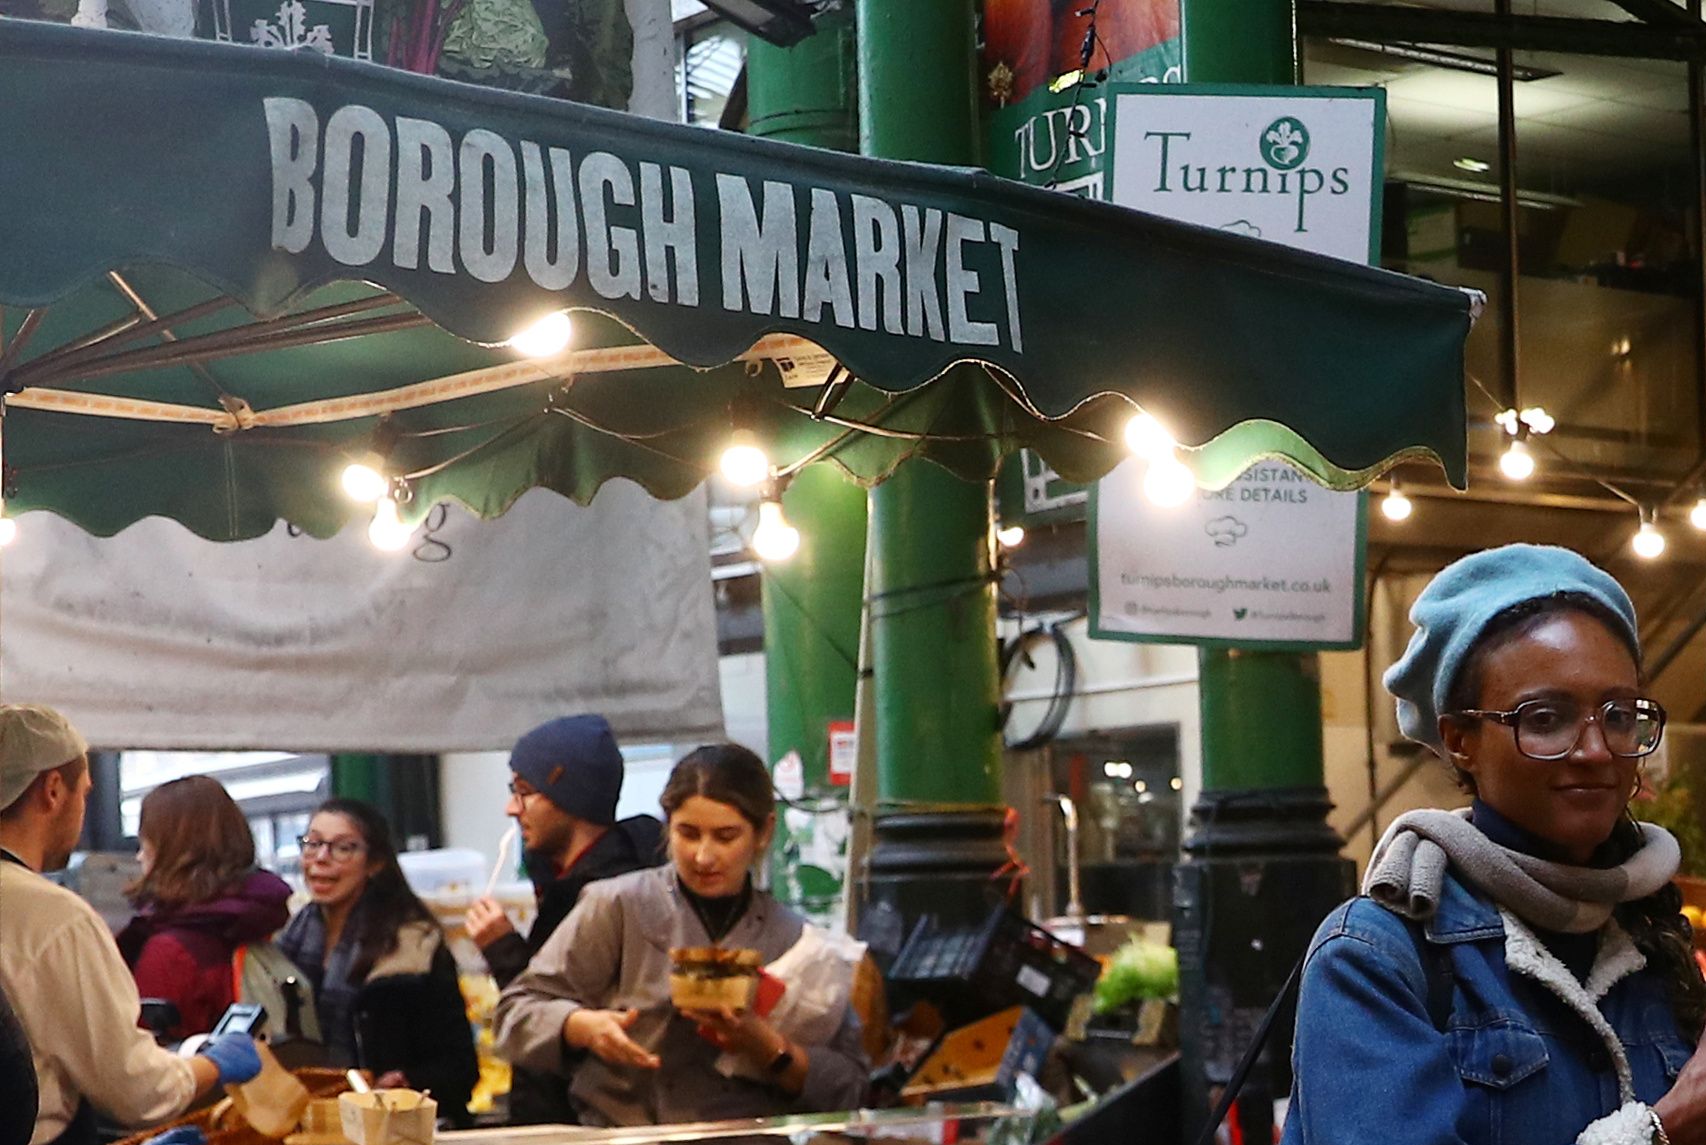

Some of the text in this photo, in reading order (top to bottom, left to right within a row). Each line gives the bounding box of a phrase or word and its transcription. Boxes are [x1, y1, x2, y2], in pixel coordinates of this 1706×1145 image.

[264, 97, 1023, 354] BOROUGH MARKET
[1144, 128, 1350, 233] Turnips
[1240, 488, 1308, 504] DETAILS
